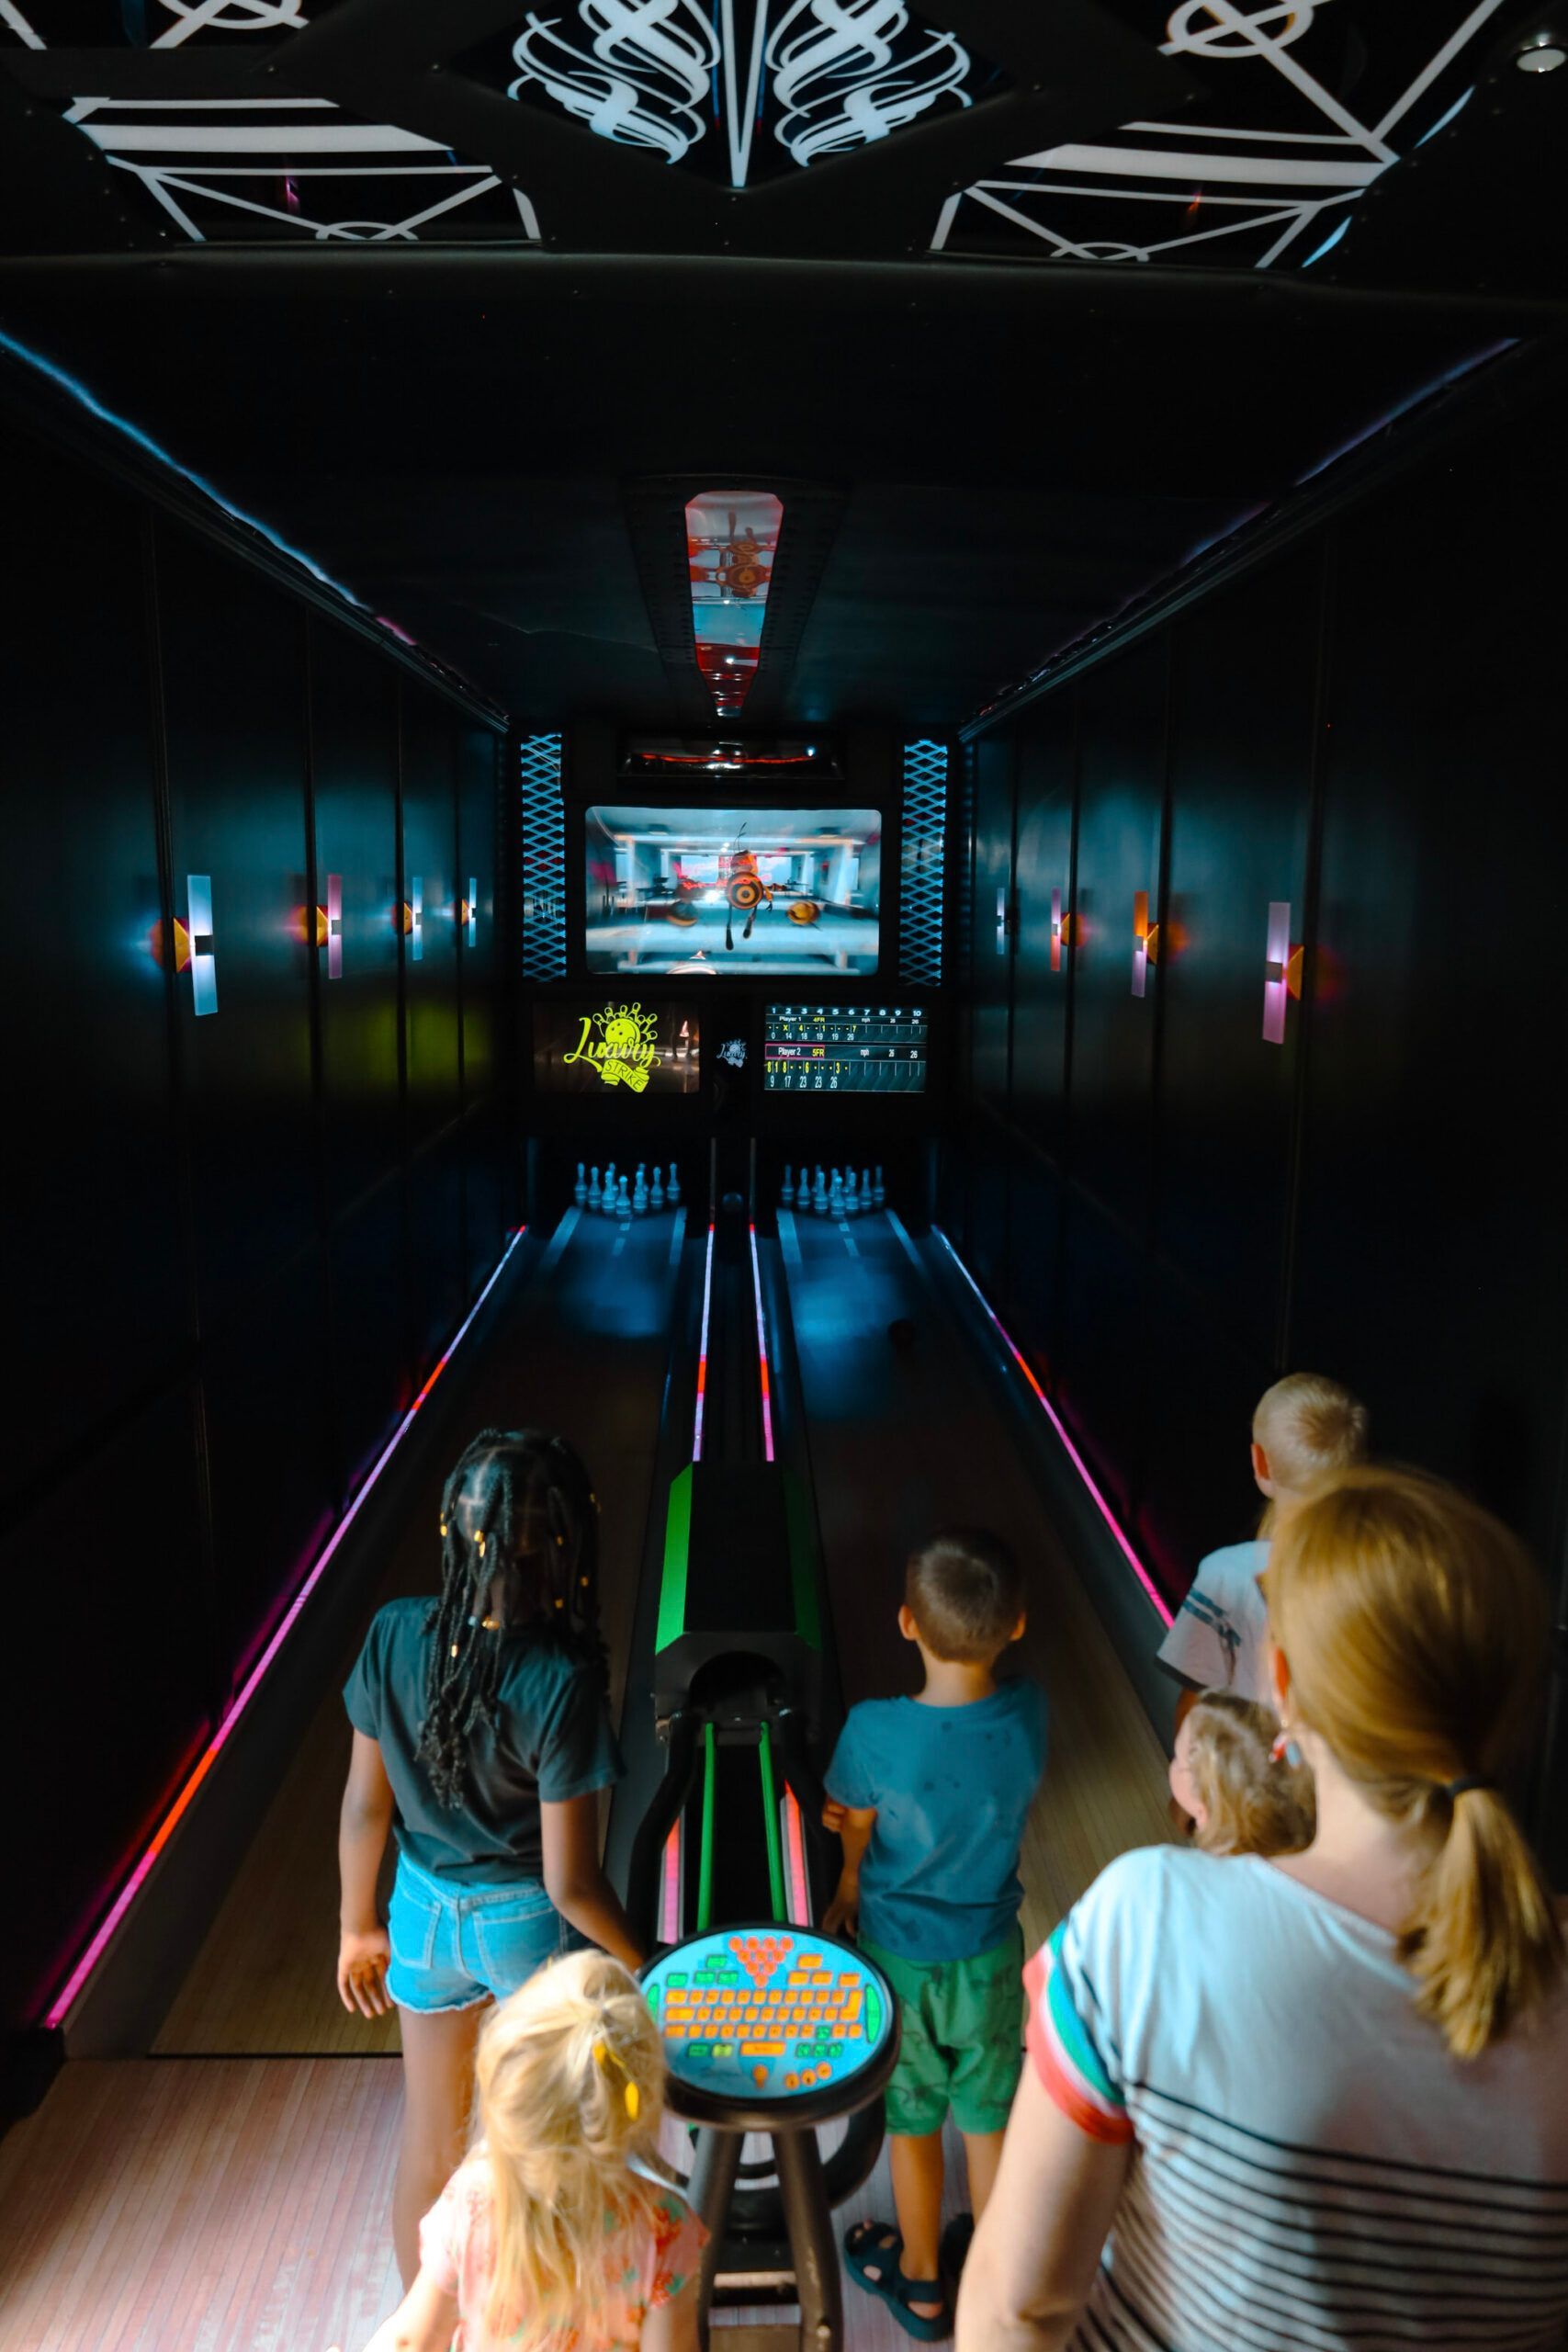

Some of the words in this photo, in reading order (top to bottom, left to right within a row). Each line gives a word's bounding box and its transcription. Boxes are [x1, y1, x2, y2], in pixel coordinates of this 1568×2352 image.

[563, 1017, 661, 1072] Luxury
[778, 1047, 795, 1057] Player
[775, 1062, 778, 1072] 1
[806, 1062, 809, 1073] 6
[836, 1062, 840, 1074] 3
[604, 1061, 645, 1091] STRIKE
[771, 1076, 774, 1087] 9
[784, 1076, 791, 1087] 17
[800, 1077, 807, 1088] 23
[815, 1077, 822, 1088] 23
[830, 1077, 837, 1088] 26
